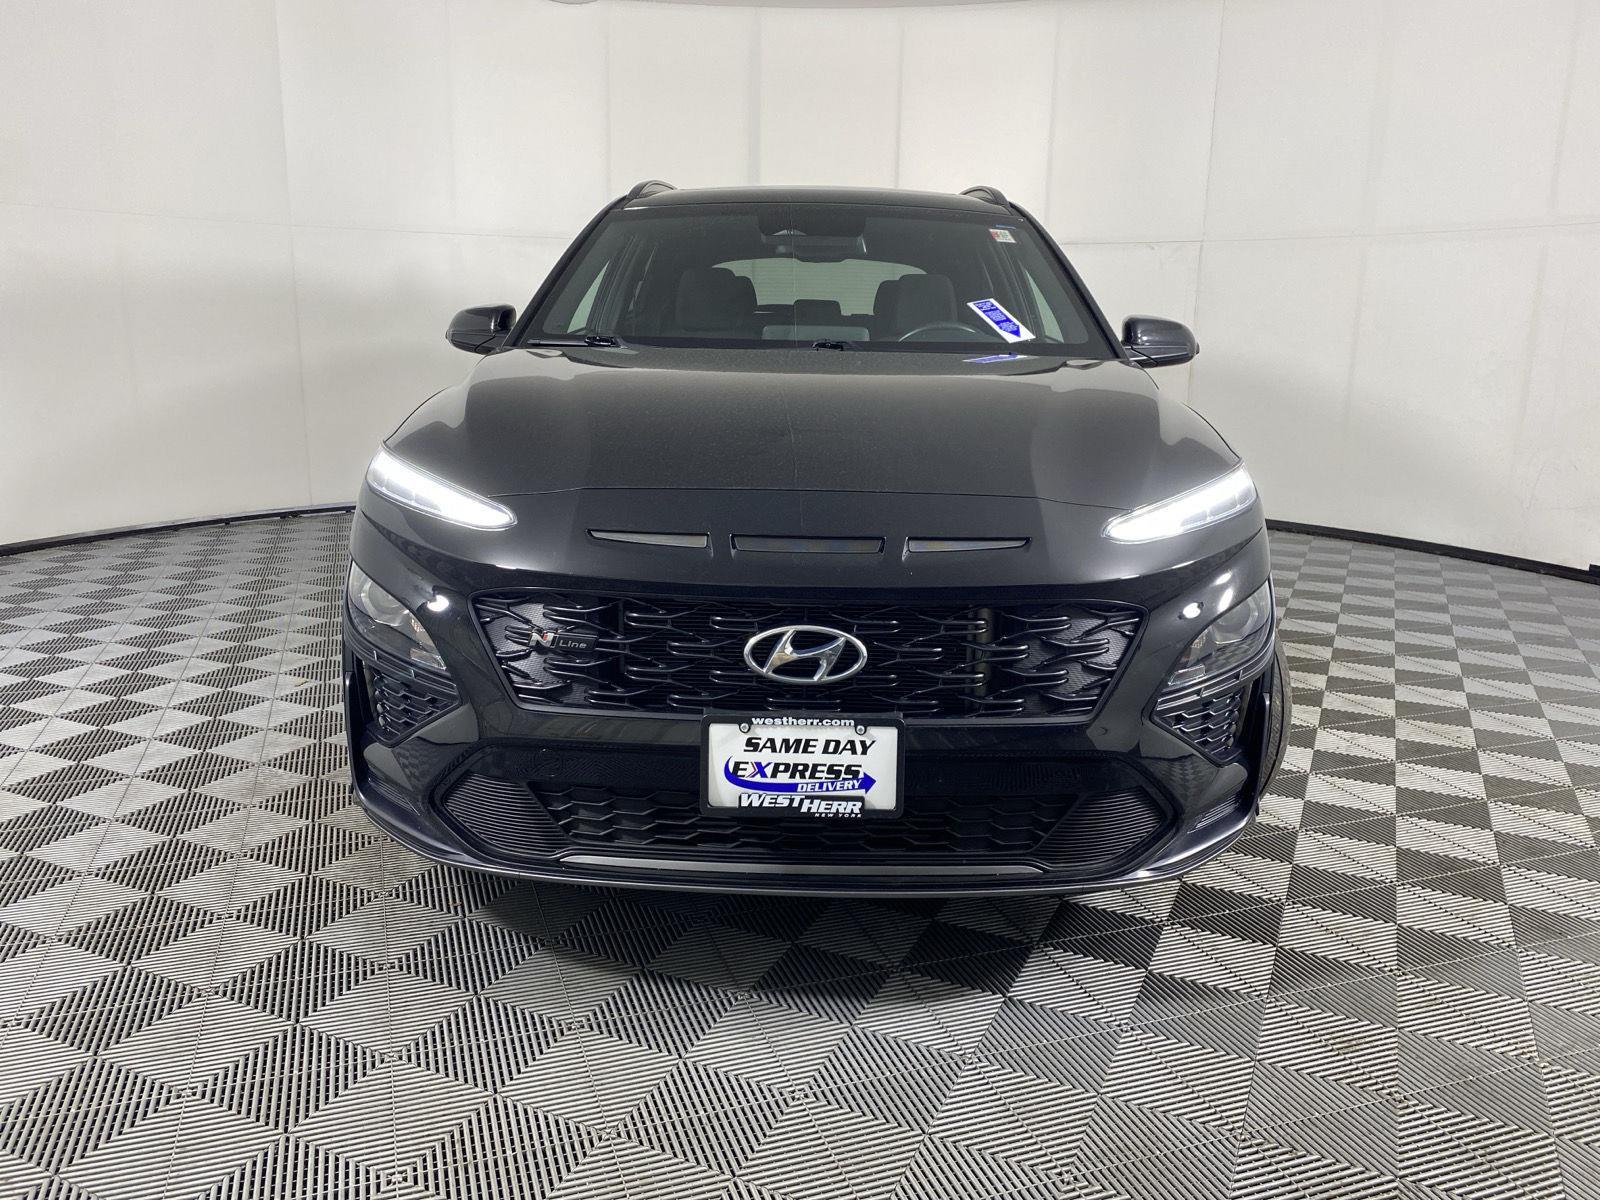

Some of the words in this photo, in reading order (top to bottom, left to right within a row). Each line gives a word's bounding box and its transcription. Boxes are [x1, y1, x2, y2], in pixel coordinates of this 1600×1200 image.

[752, 716, 854, 726] westherr.com
[744, 737, 818, 754] SAME
[822, 739, 876, 755] DAY
[731, 761, 862, 780] EXPRESS
[797, 780, 861, 792] DELIVERY
